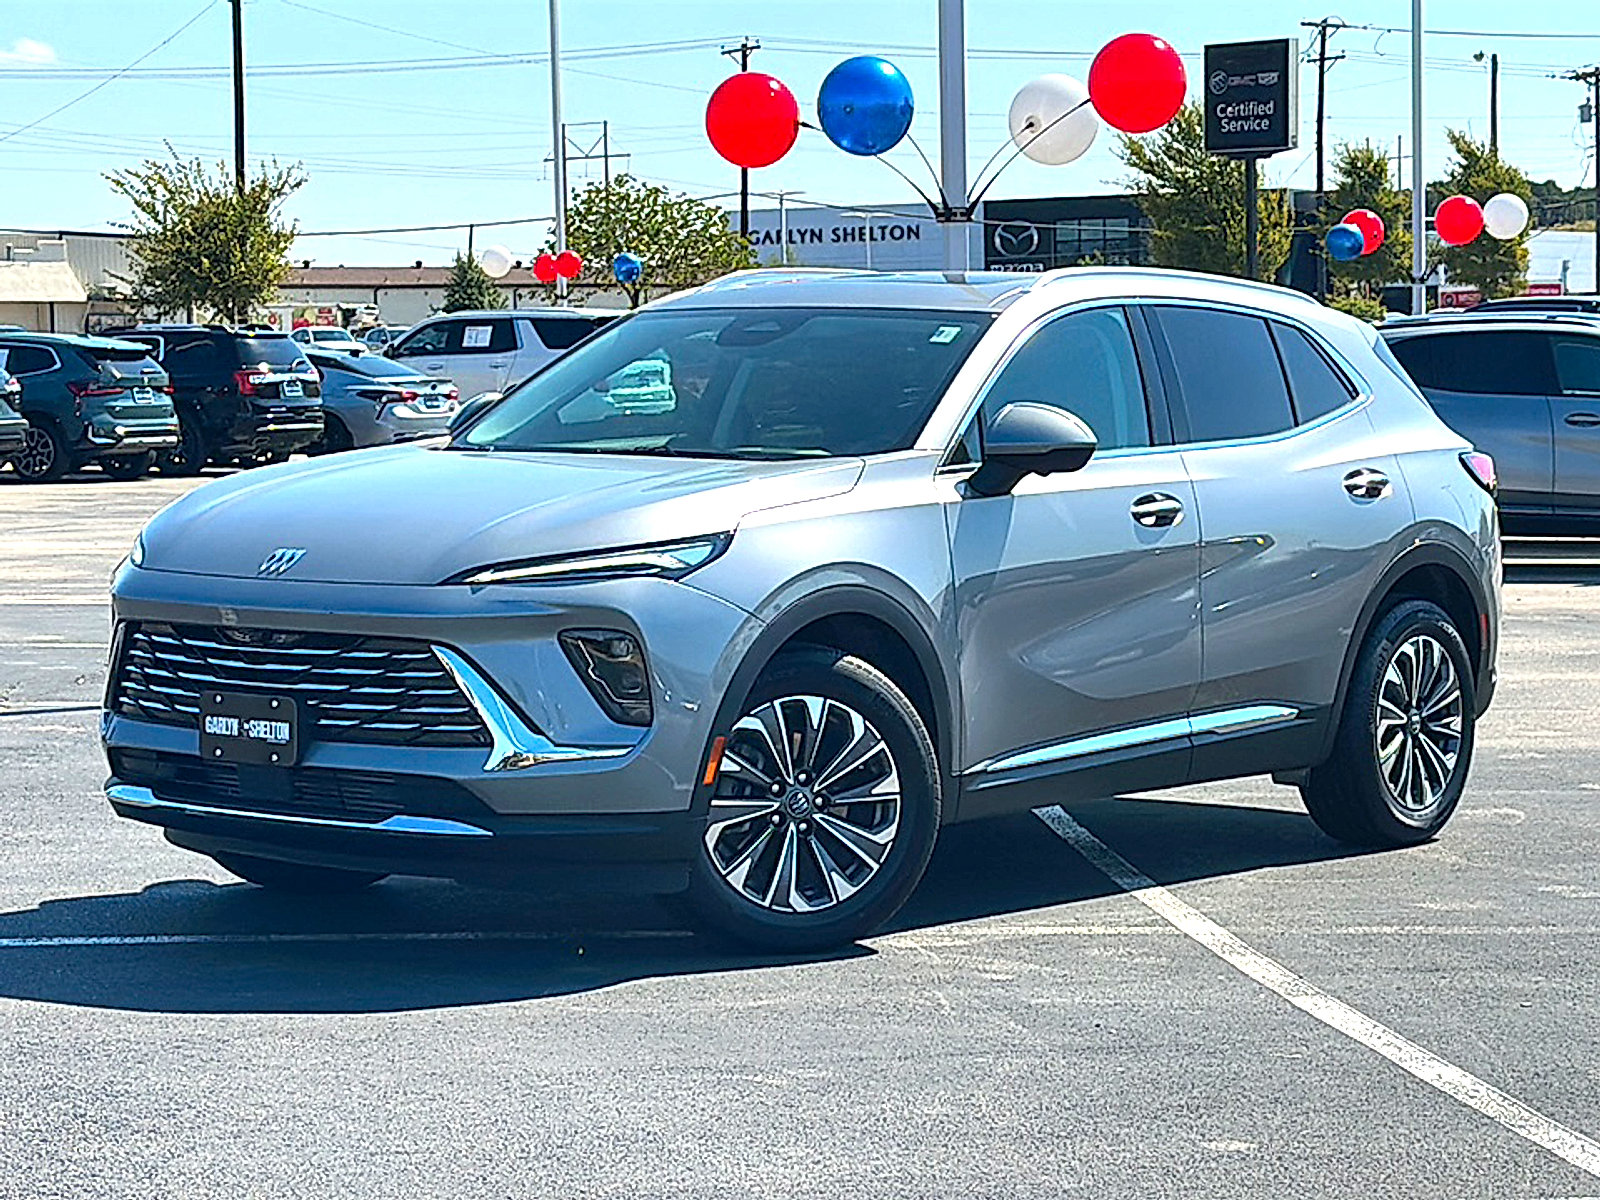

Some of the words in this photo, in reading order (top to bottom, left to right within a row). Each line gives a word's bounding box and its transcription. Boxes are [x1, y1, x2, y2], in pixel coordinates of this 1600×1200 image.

[1216, 100, 1274, 118] Certified
[1220, 117, 1270, 133] Service
[830, 224, 920, 243] SHELTON
[204, 715, 239, 736] GARLYN
[248, 719, 290, 741] SHELTON
